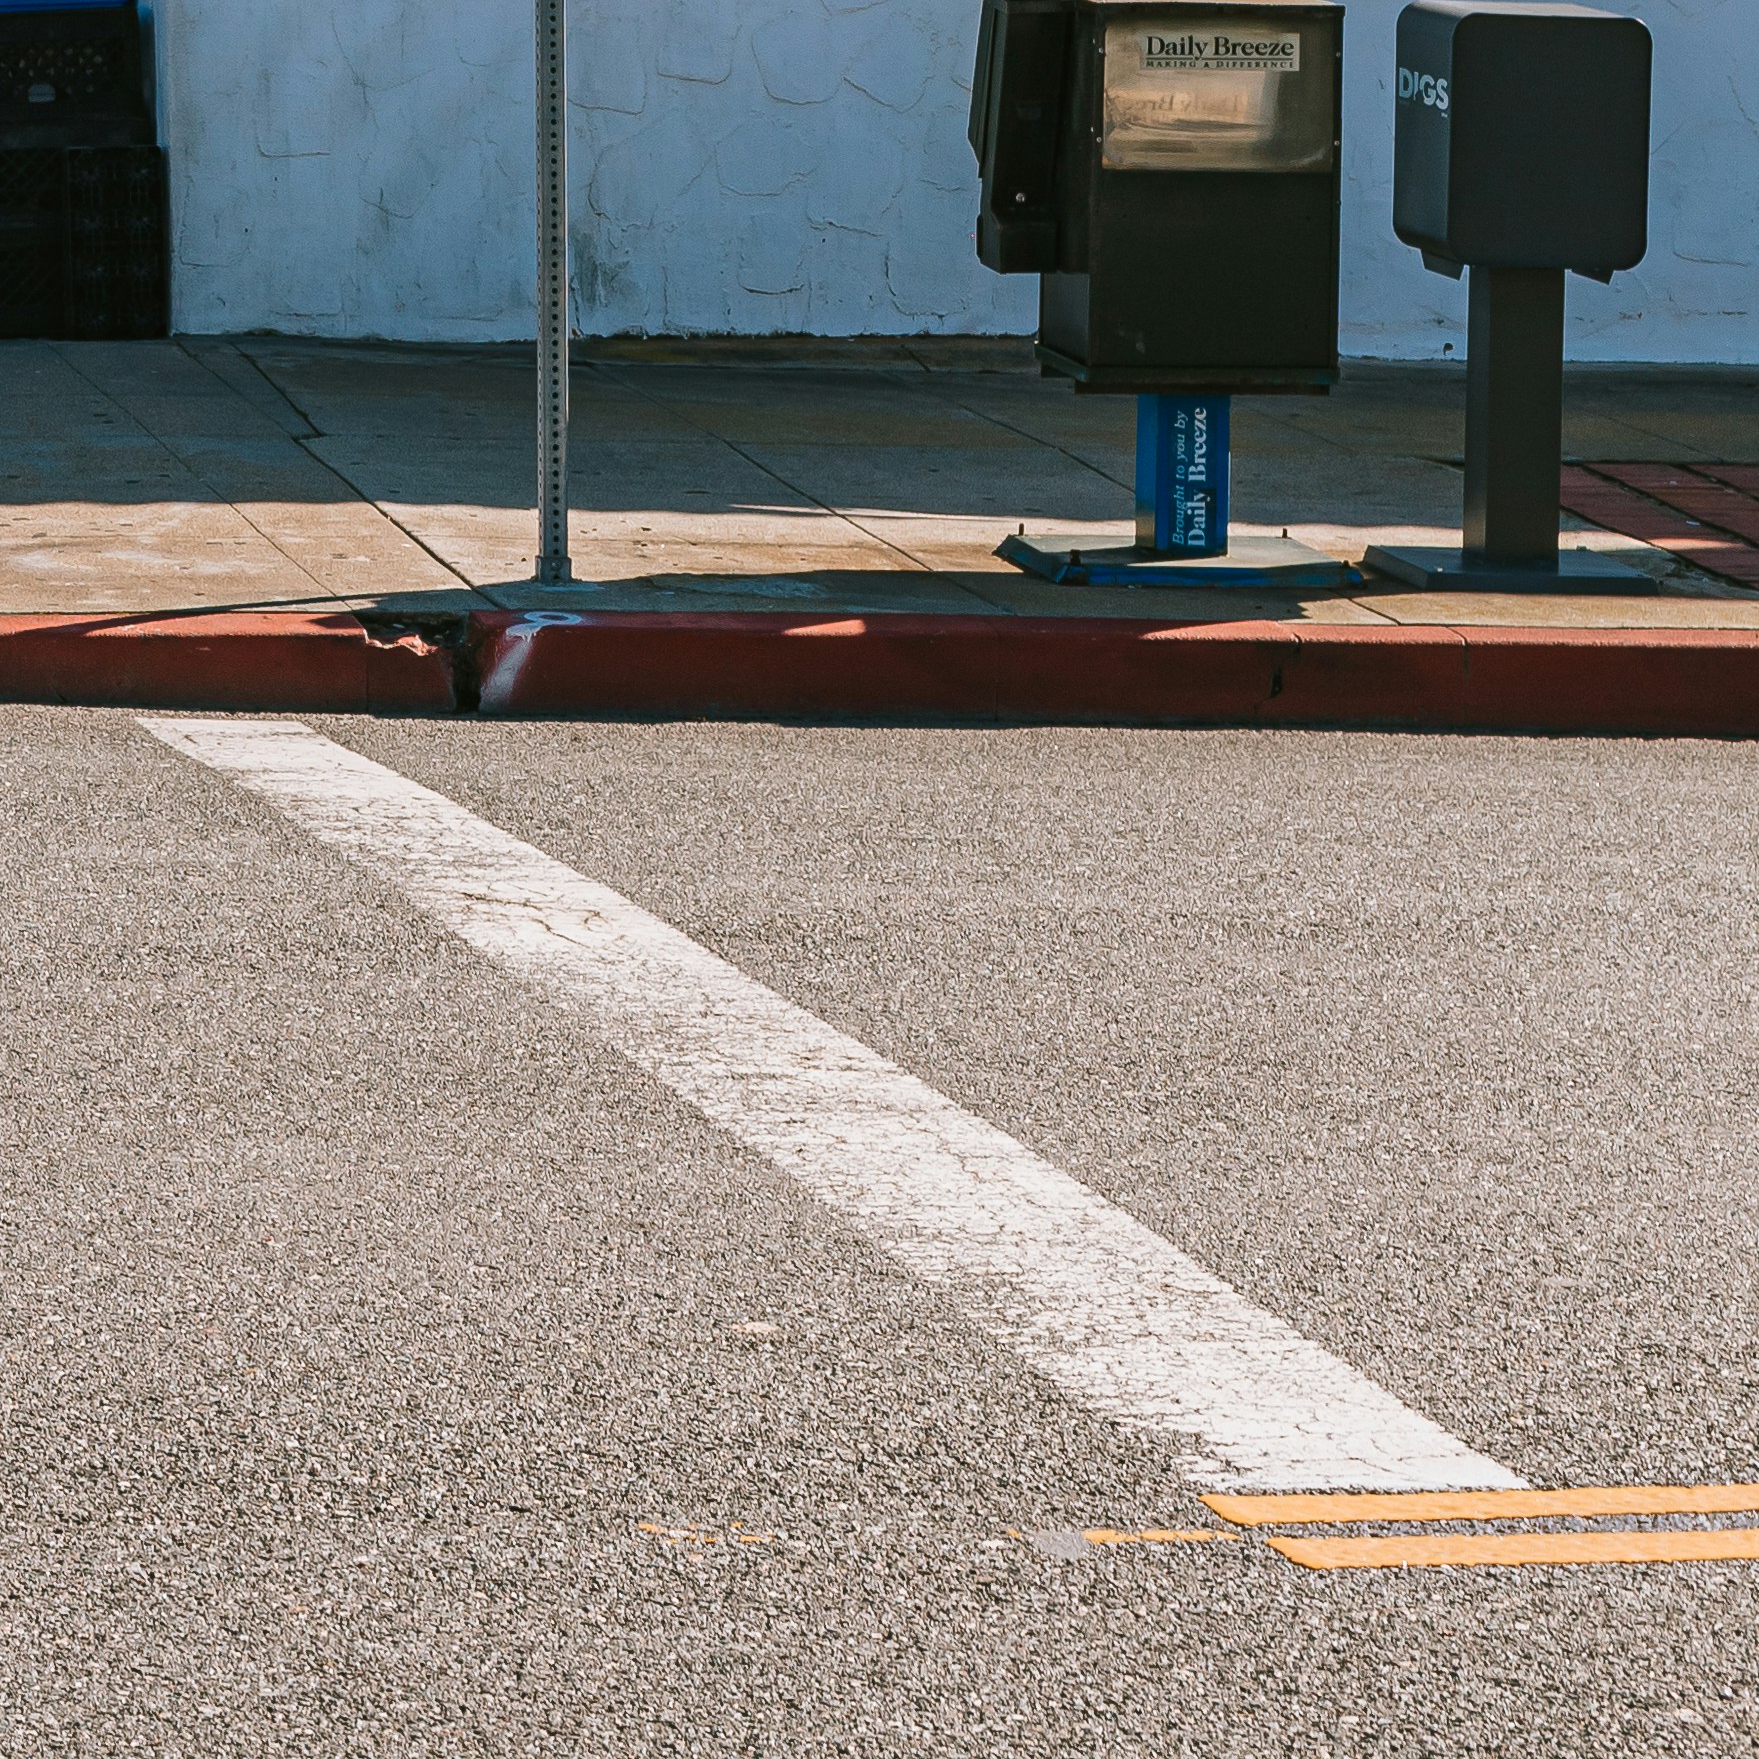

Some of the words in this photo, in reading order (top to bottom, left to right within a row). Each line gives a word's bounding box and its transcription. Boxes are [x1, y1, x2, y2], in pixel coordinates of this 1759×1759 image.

[1146, 34, 1208, 60] Daily
[1213, 35, 1295, 57] Breeze
[1146, 60, 1197, 69] MAKING
[1216, 60, 1294, 69] DIFFERENCE
[1398, 67, 1449, 110] DIGS
[1174, 410, 1189, 430] by
[1176, 434, 1188, 462] you
[1188, 407, 1207, 482] Breeze
[1176, 465, 1185, 479] to
[1173, 485, 1188, 546] Brought
[1187, 489, 1211, 547] Daily
